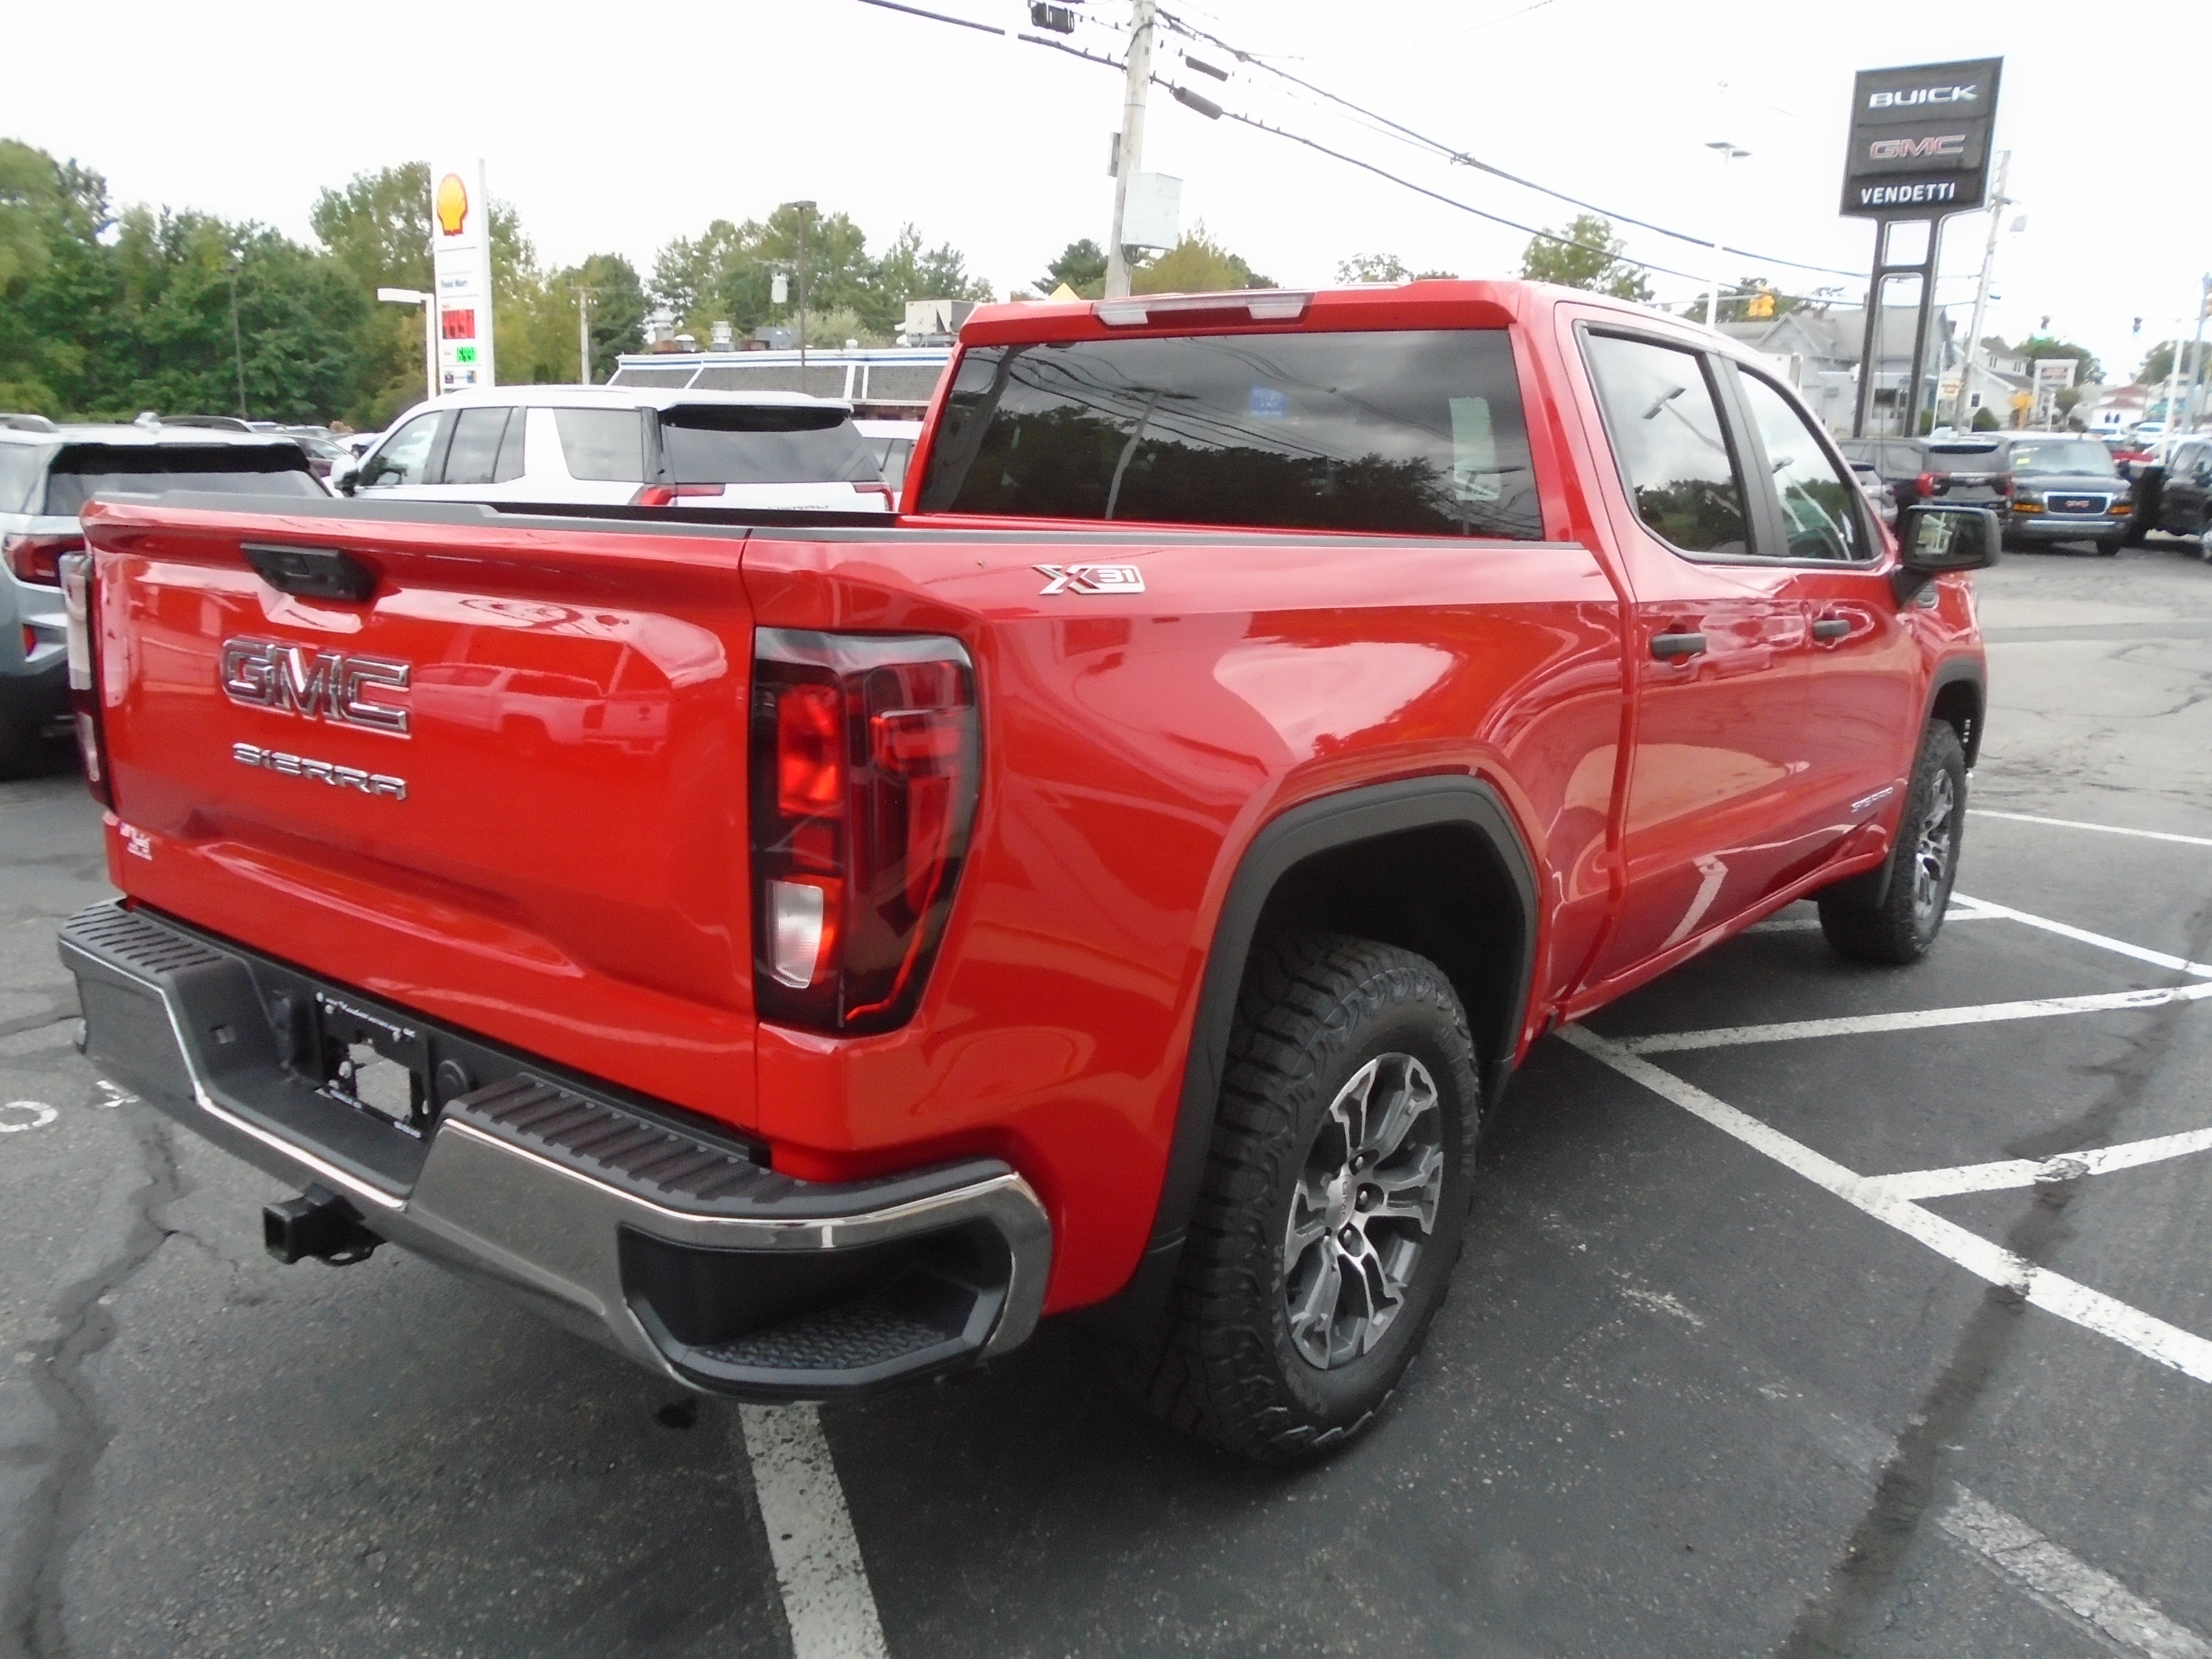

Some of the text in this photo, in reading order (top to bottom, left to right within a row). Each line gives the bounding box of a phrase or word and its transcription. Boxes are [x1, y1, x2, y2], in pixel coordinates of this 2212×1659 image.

[1868, 84, 1978, 109] BUICK
[1869, 134, 1966, 159] GMC
[1860, 183, 1956, 204] VENDETTI
[1031, 565, 1146, 595] X31
[220, 637, 411, 732] GMC
[233, 742, 407, 801] SIERRA
